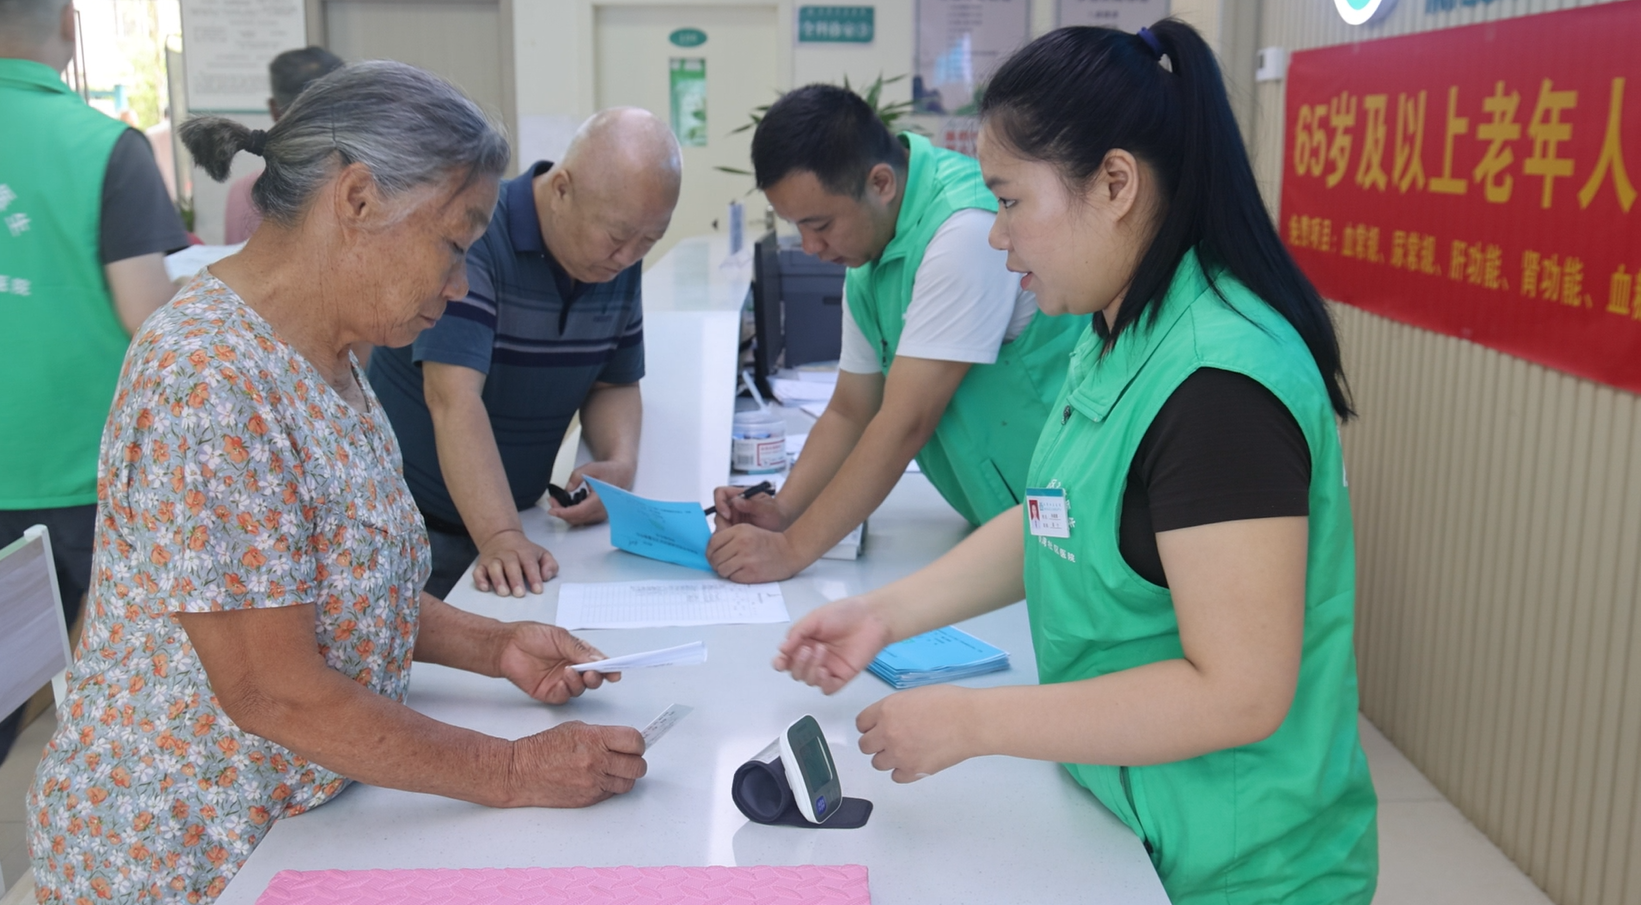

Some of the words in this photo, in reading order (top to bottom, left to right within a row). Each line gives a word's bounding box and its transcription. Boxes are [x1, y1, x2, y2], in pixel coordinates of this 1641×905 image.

[1294, 77, 1638, 213] 65岁及以上老年人
